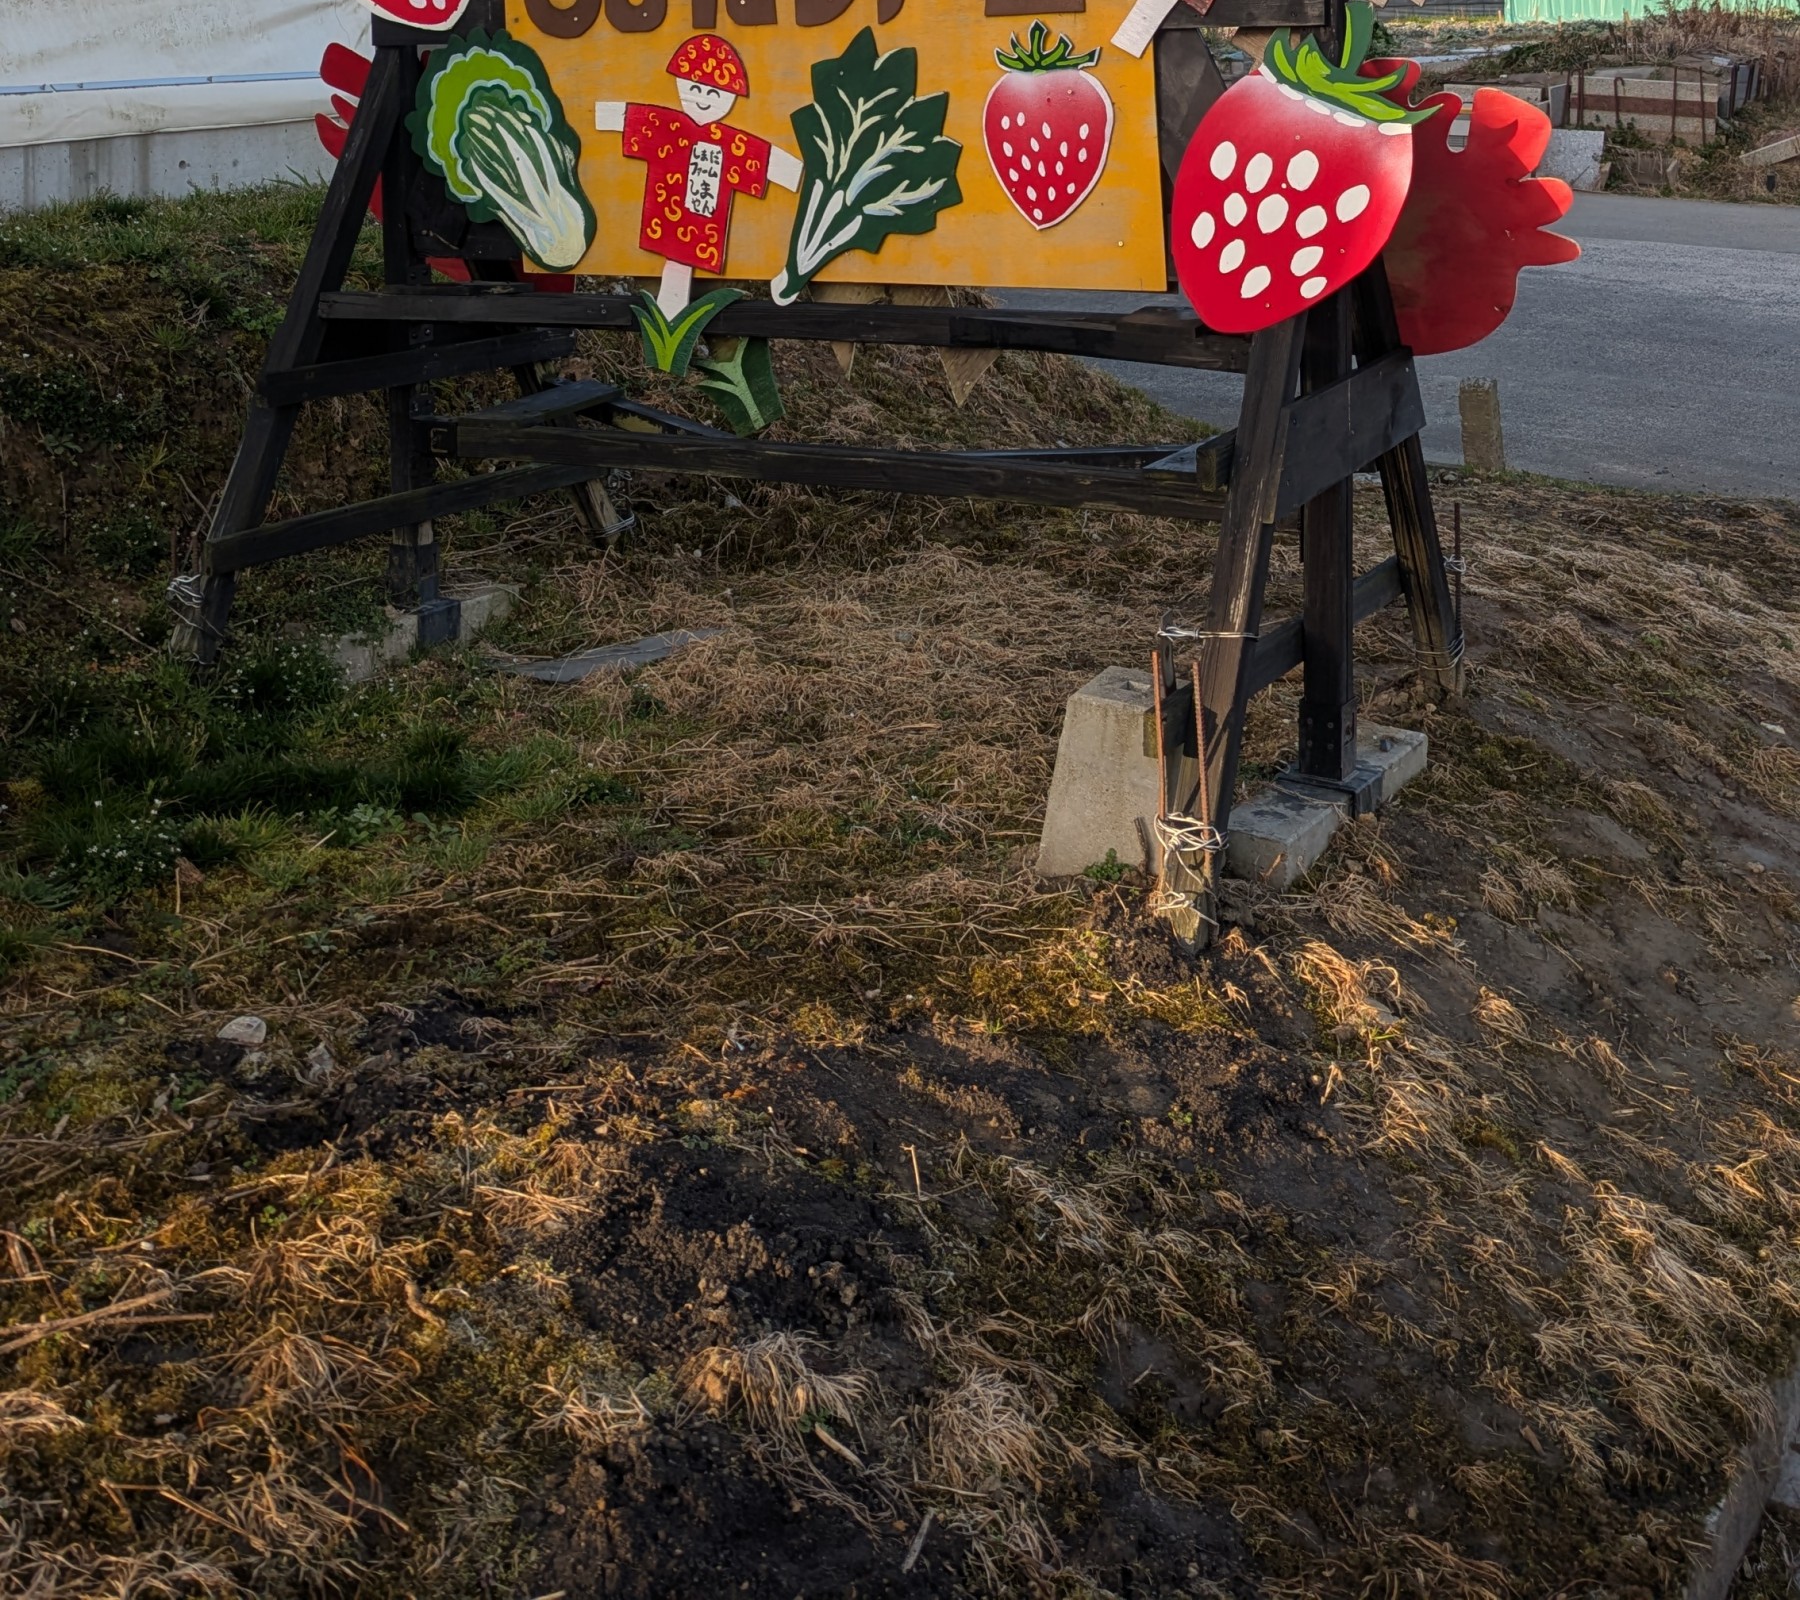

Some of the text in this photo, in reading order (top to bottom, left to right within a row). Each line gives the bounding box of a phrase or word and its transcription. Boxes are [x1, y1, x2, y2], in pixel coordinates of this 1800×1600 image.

[693, 146, 722, 165] しまだ
[690, 161, 718, 178] ファーム
[689, 178, 714, 200] しま
